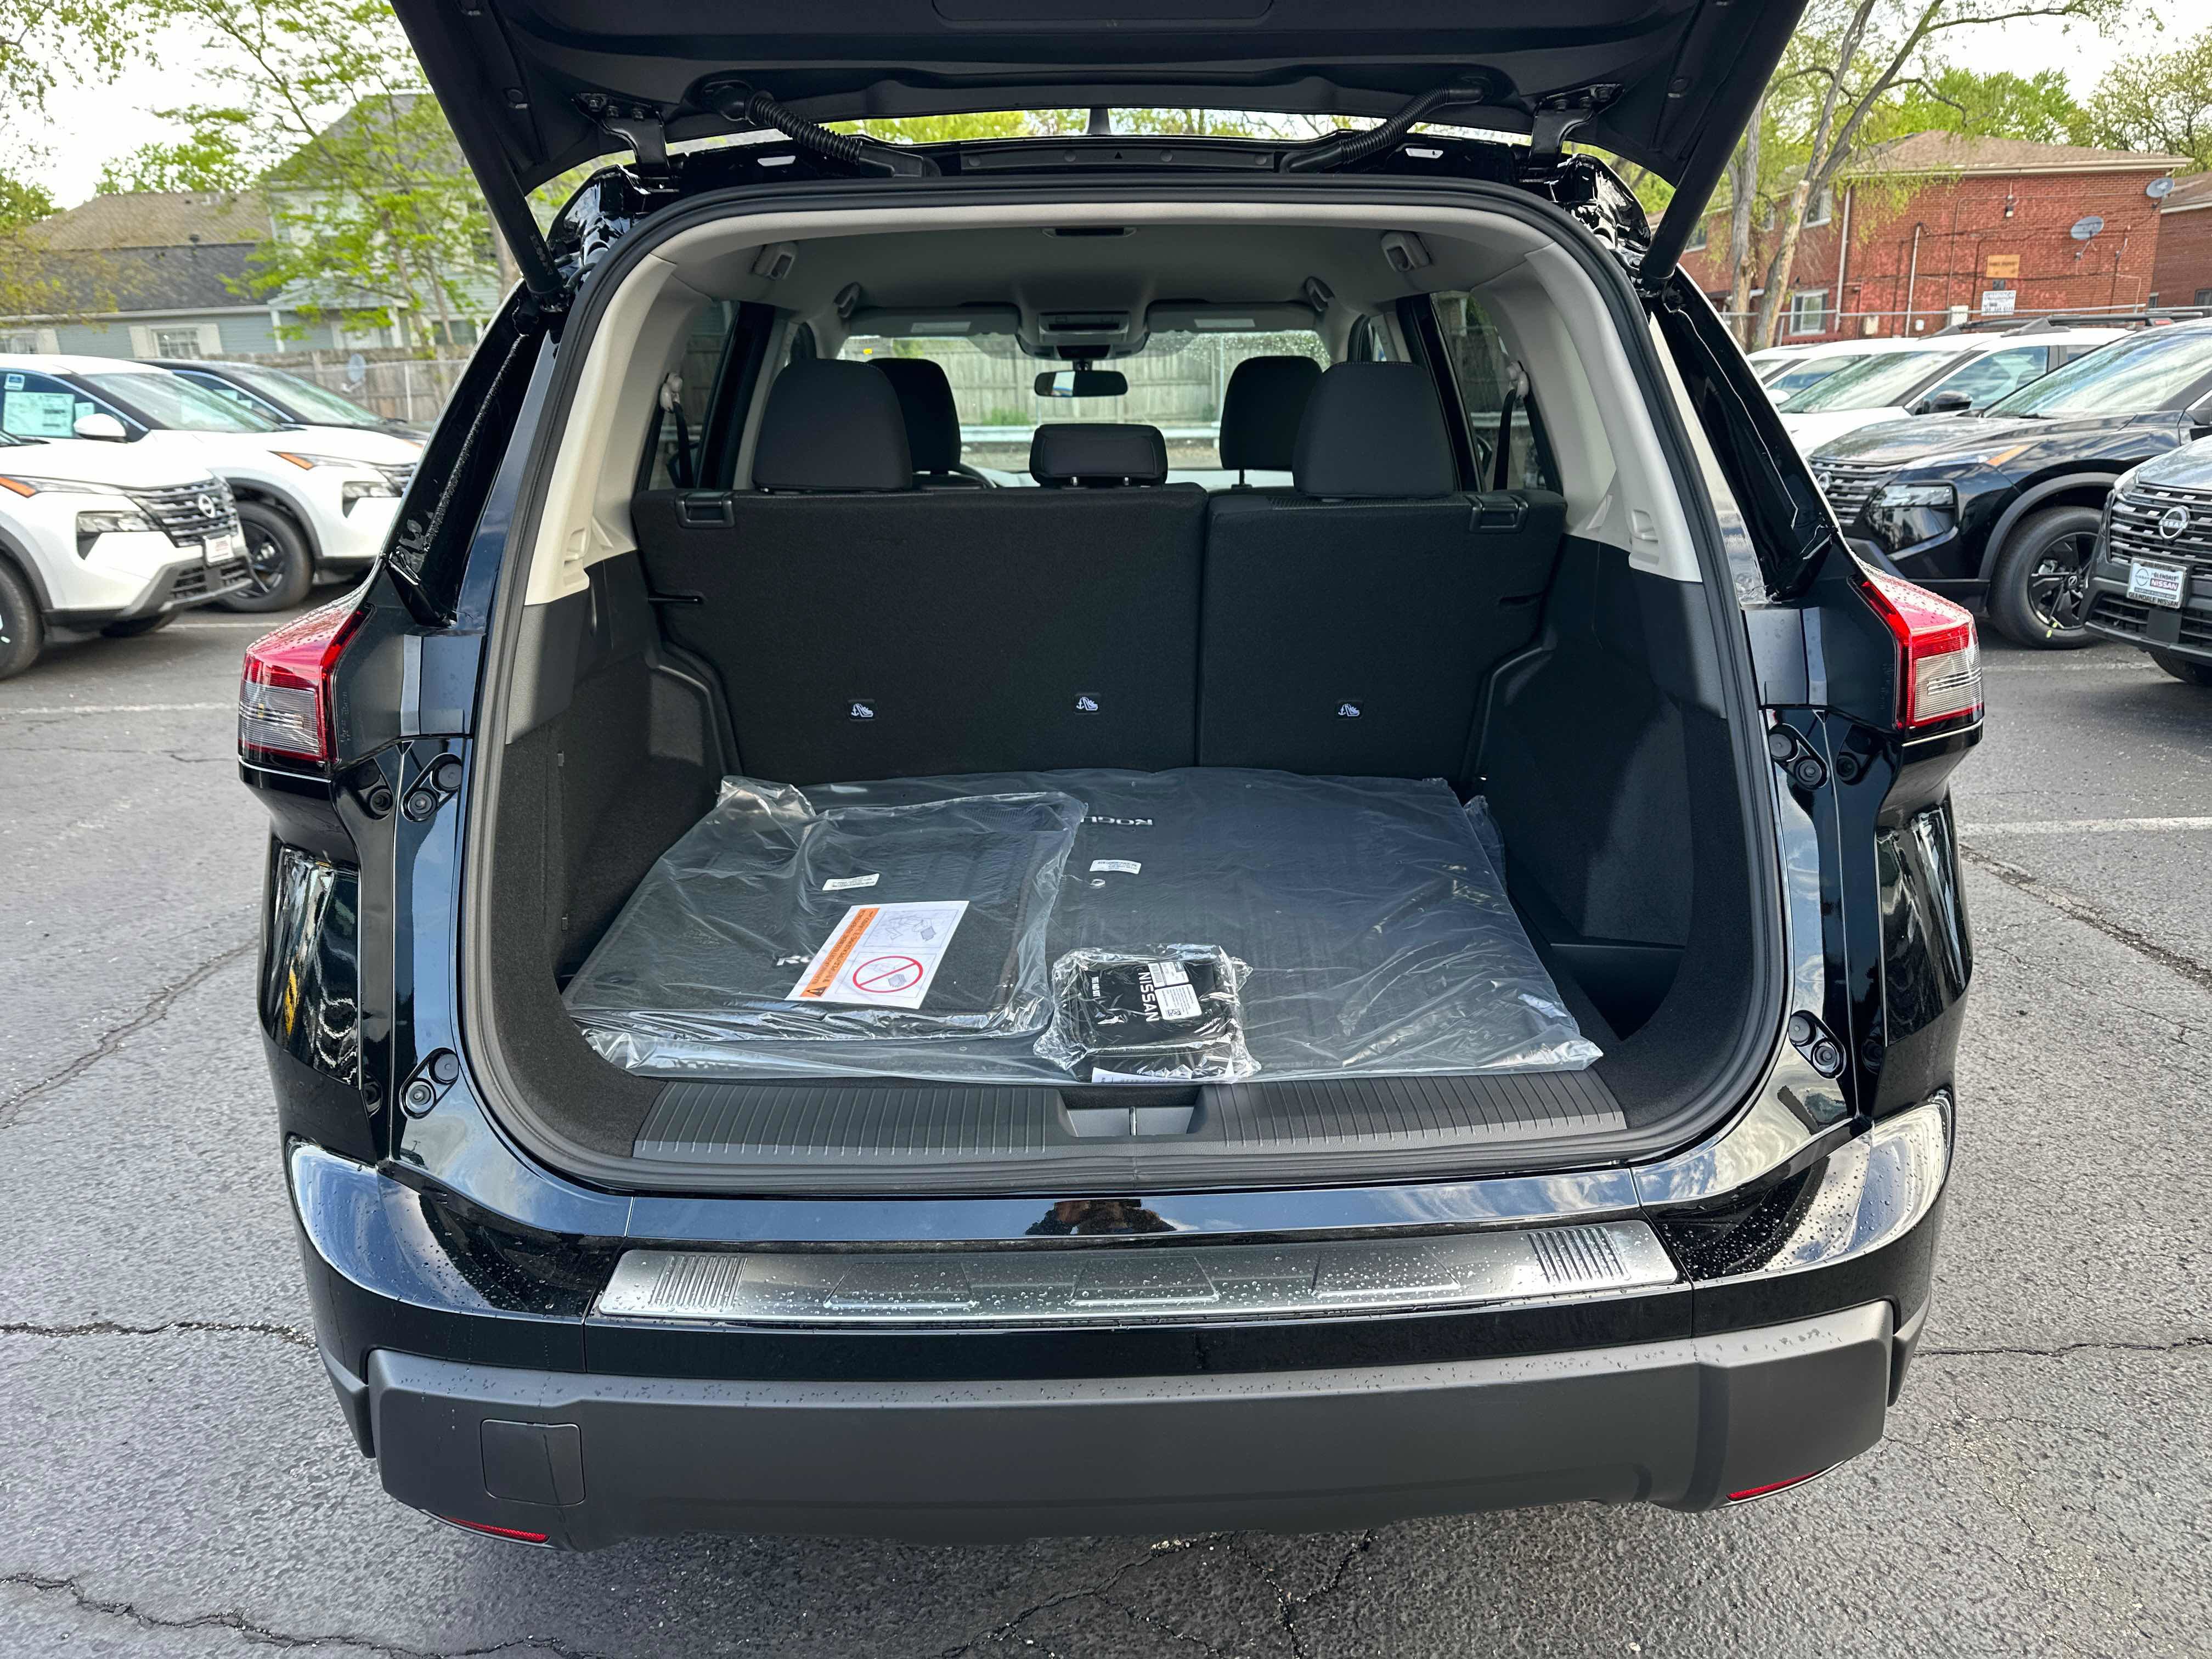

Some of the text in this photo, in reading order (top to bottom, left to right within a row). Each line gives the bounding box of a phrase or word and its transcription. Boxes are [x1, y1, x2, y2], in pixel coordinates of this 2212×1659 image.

[2151, 579, 2177, 590] NISSAN
[2129, 592, 2157, 602] GLENDALE
[2157, 597, 2179, 607] NISSAN
[1138, 972, 1160, 1022] NISSAN
